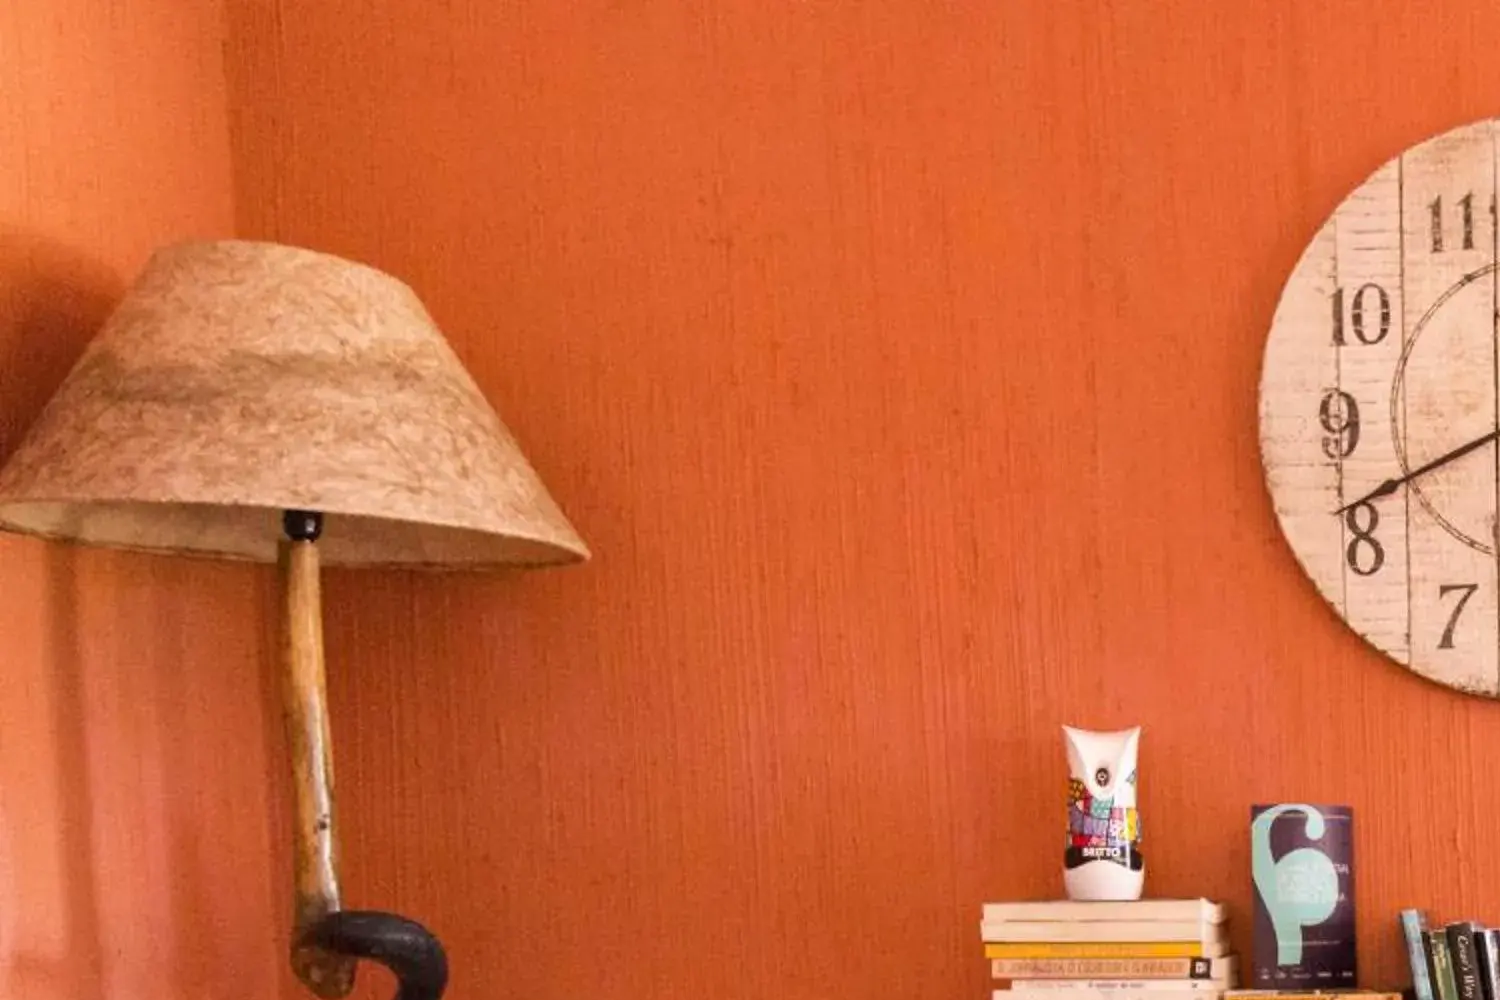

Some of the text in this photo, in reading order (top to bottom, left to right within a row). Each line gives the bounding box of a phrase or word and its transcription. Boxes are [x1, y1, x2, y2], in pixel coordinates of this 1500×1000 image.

[1430, 191, 1475, 254] 11
[1330, 282, 1391, 347] 10
[1319, 391, 1359, 460] 9
[1346, 501, 1385, 576] 8
[1438, 584, 1478, 649] 7
